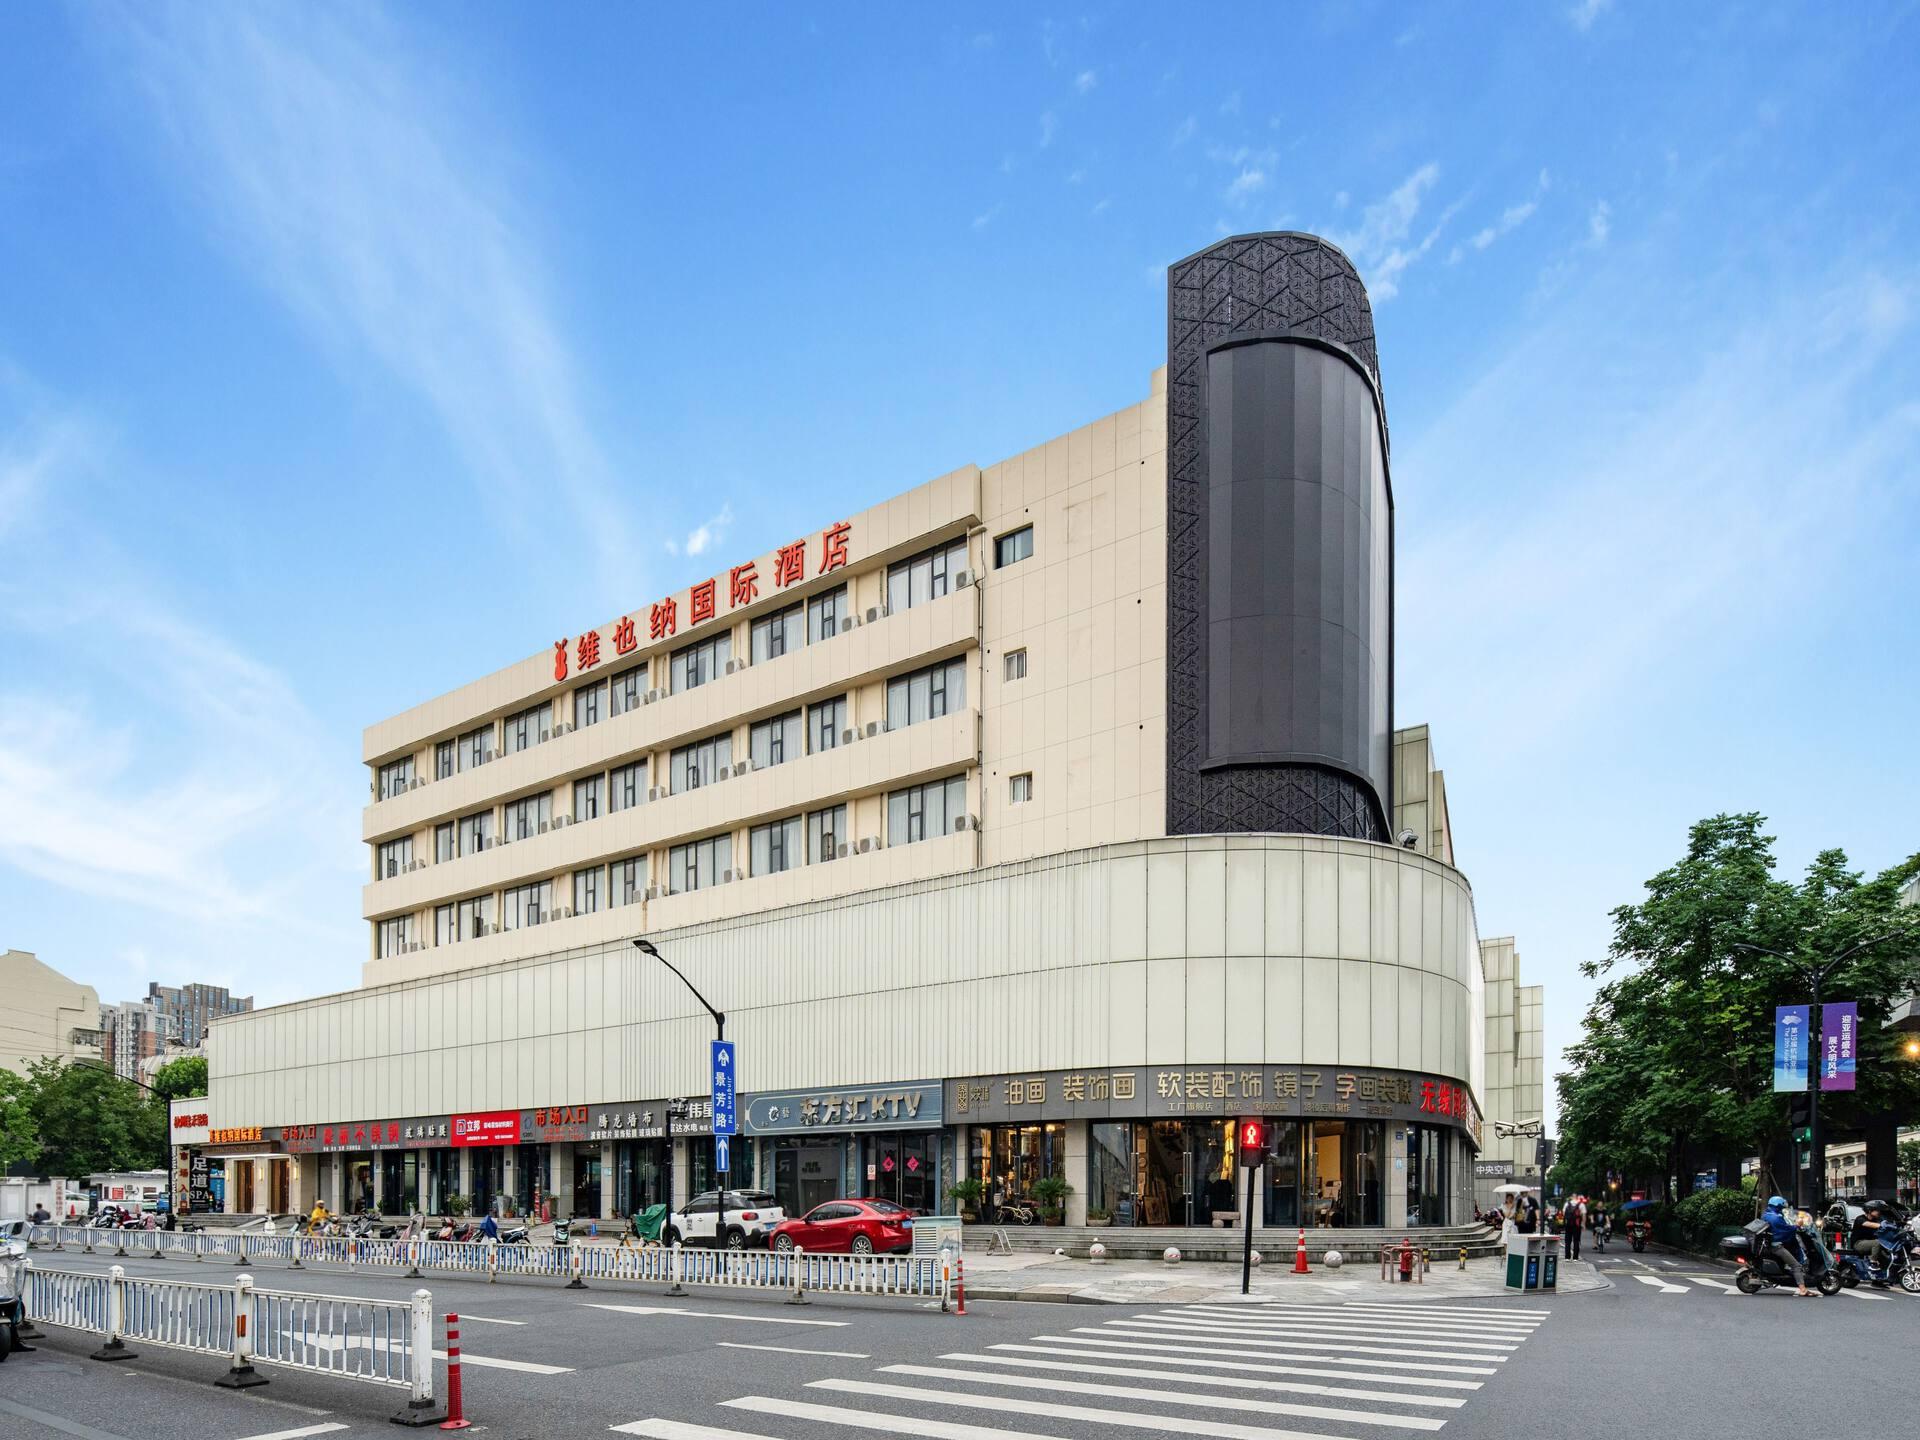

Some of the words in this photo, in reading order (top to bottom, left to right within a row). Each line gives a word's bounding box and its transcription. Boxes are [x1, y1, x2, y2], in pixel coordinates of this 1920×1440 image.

[577, 521, 851, 670] 维也纳国际酒店
[1841, 1014, 1852, 1058] 迎亚运盛会
[1827, 1036, 1838, 1079] 展文明风采
[715, 1071, 726, 1128] 景芳路
[1003, 1077, 1047, 1105] 油画
[1063, 1072, 1136, 1101] 装饰画
[1157, 1071, 1263, 1098] 软装配饰
[1274, 1071, 1323, 1099] 镜子
[535, 1106, 587, 1127] 市场入口
[689, 1102, 713, 1119] 伟星
[799, 1091, 921, 1126] 东方汇KTV
[281, 1125, 317, 1141] 市场入口
[191, 1157, 208, 1188] 足道
[1476, 1164, 1513, 1175] 中央空调
[190, 1191, 209, 1200] SPA
